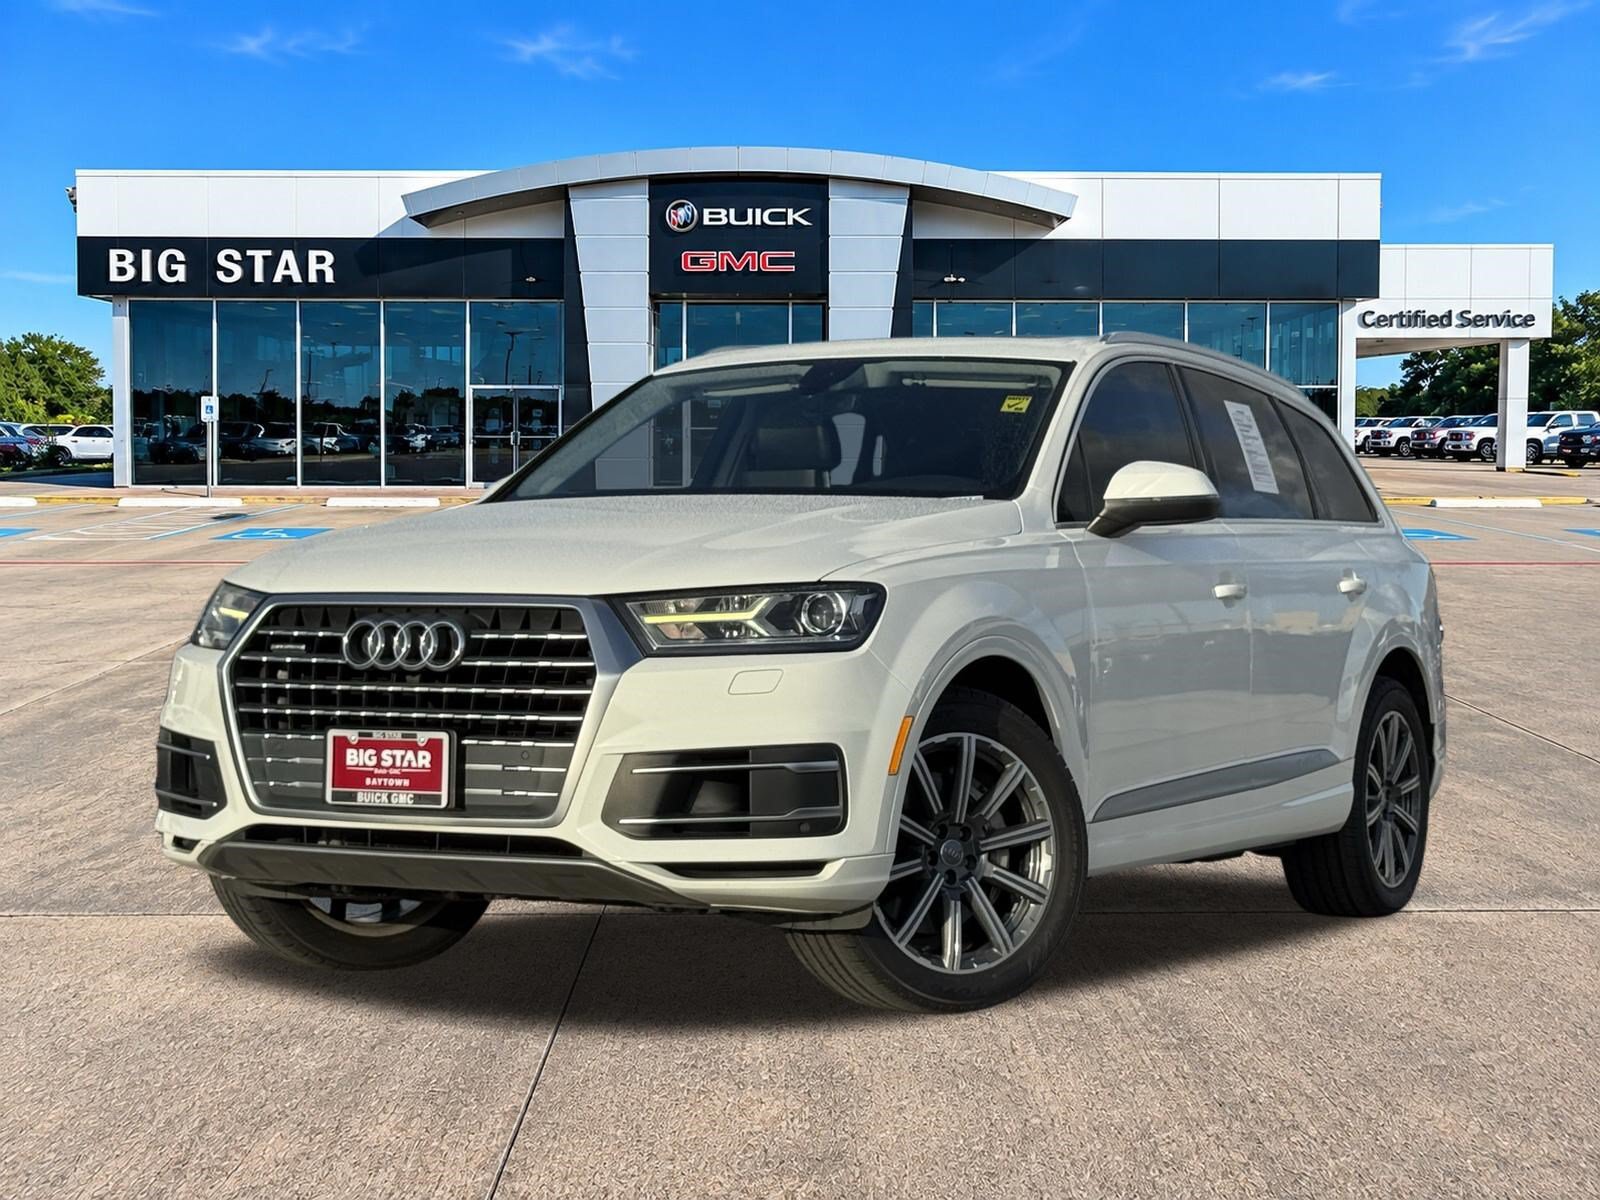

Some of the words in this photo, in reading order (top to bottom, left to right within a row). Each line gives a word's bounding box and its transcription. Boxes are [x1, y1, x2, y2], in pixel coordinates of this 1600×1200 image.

[703, 208, 813, 226] BUICK
[108, 248, 187, 283] BIG
[216, 248, 336, 283] STAR
[681, 251, 796, 272] GMC
[1360, 310, 1453, 328] Certified
[1455, 310, 1536, 328] Service
[345, 748, 378, 767] BIG
[380, 749, 432, 769] STAR
[365, 777, 410, 787] BAYTOWN
[357, 791, 389, 804] BUICK
[391, 792, 415, 805] GMC
